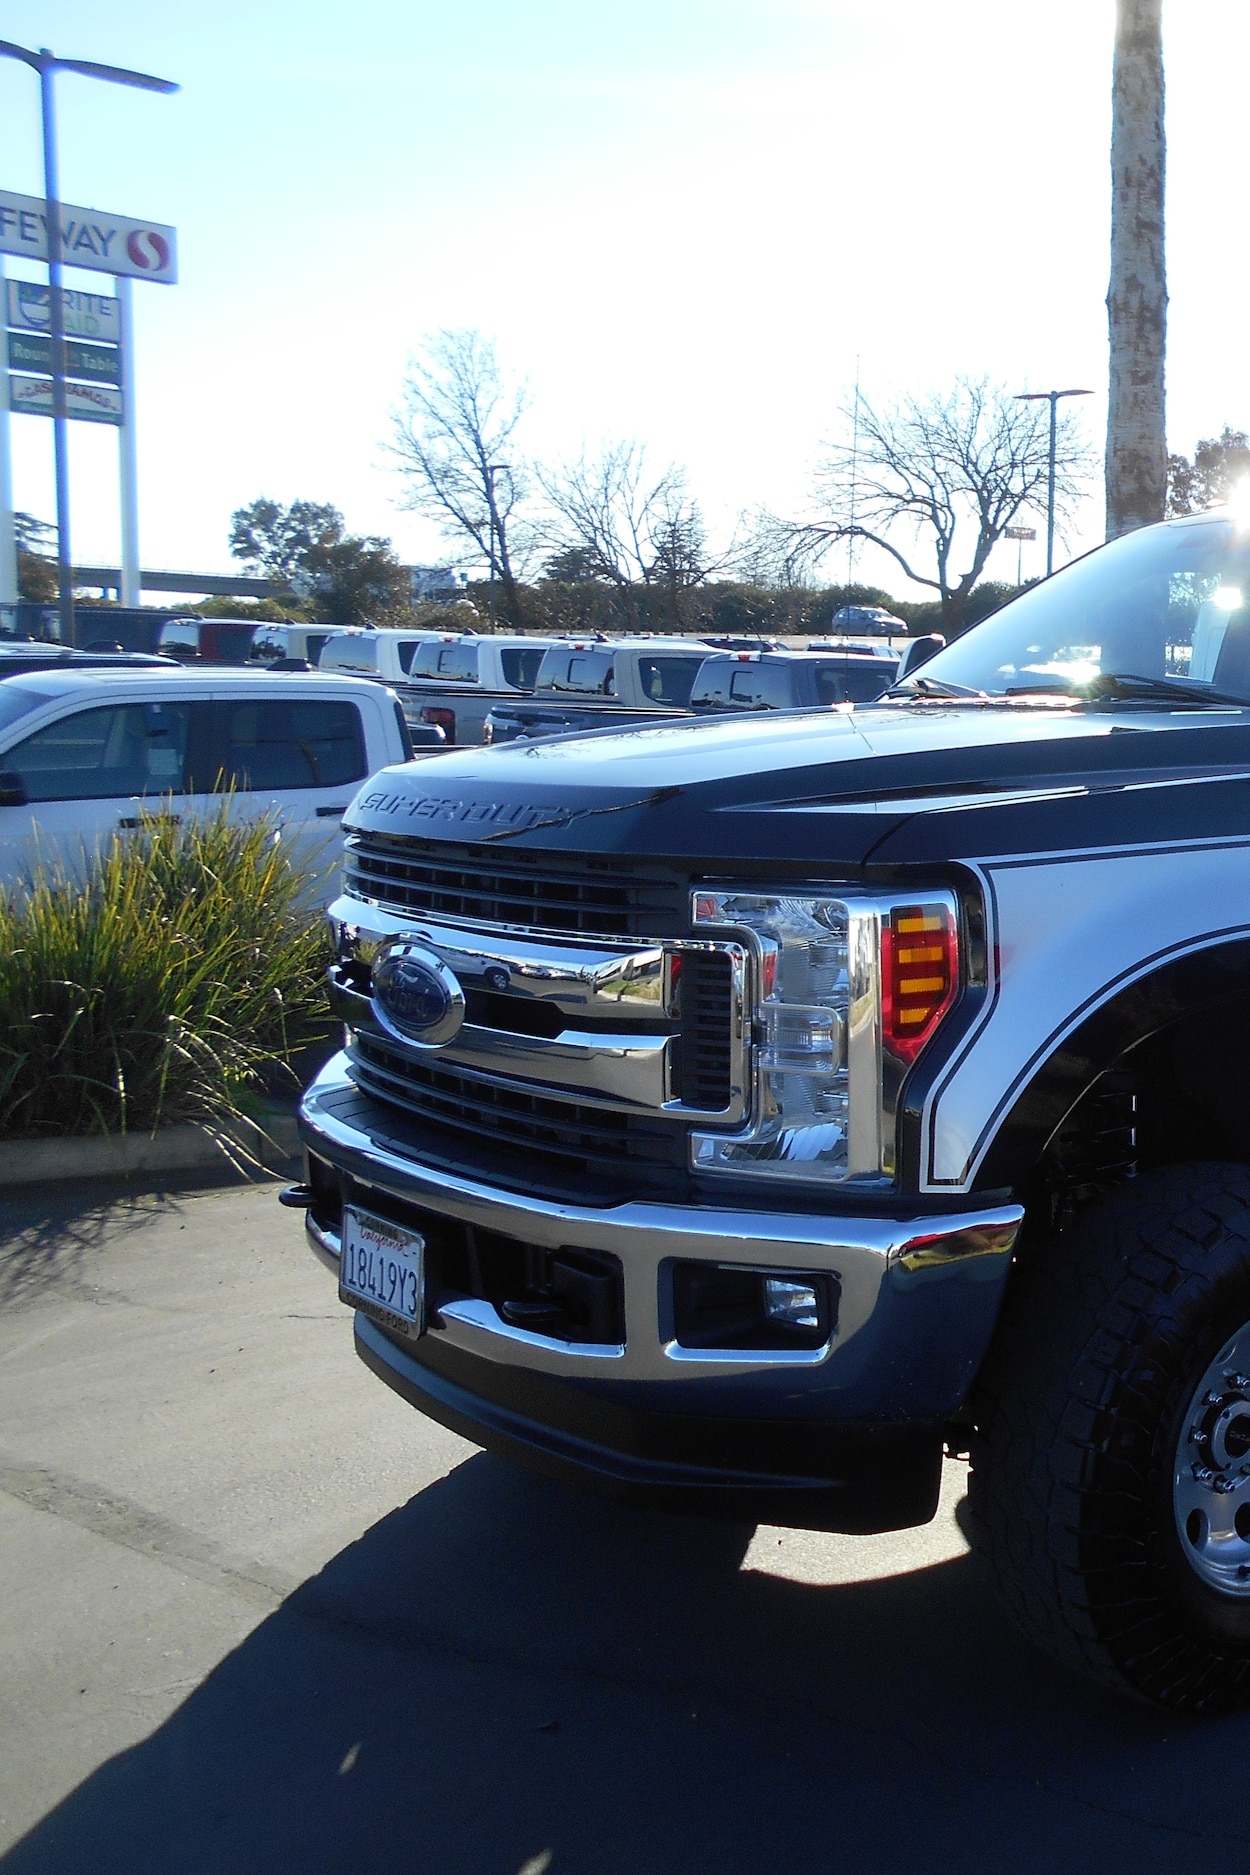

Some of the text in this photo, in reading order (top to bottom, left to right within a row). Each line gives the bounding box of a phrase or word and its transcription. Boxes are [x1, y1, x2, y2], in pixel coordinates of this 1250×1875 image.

[12, 342, 50, 363] Roun
[360, 793, 593, 830] SUPER DUTY
[348, 1243, 418, 1316] 18419Y3
